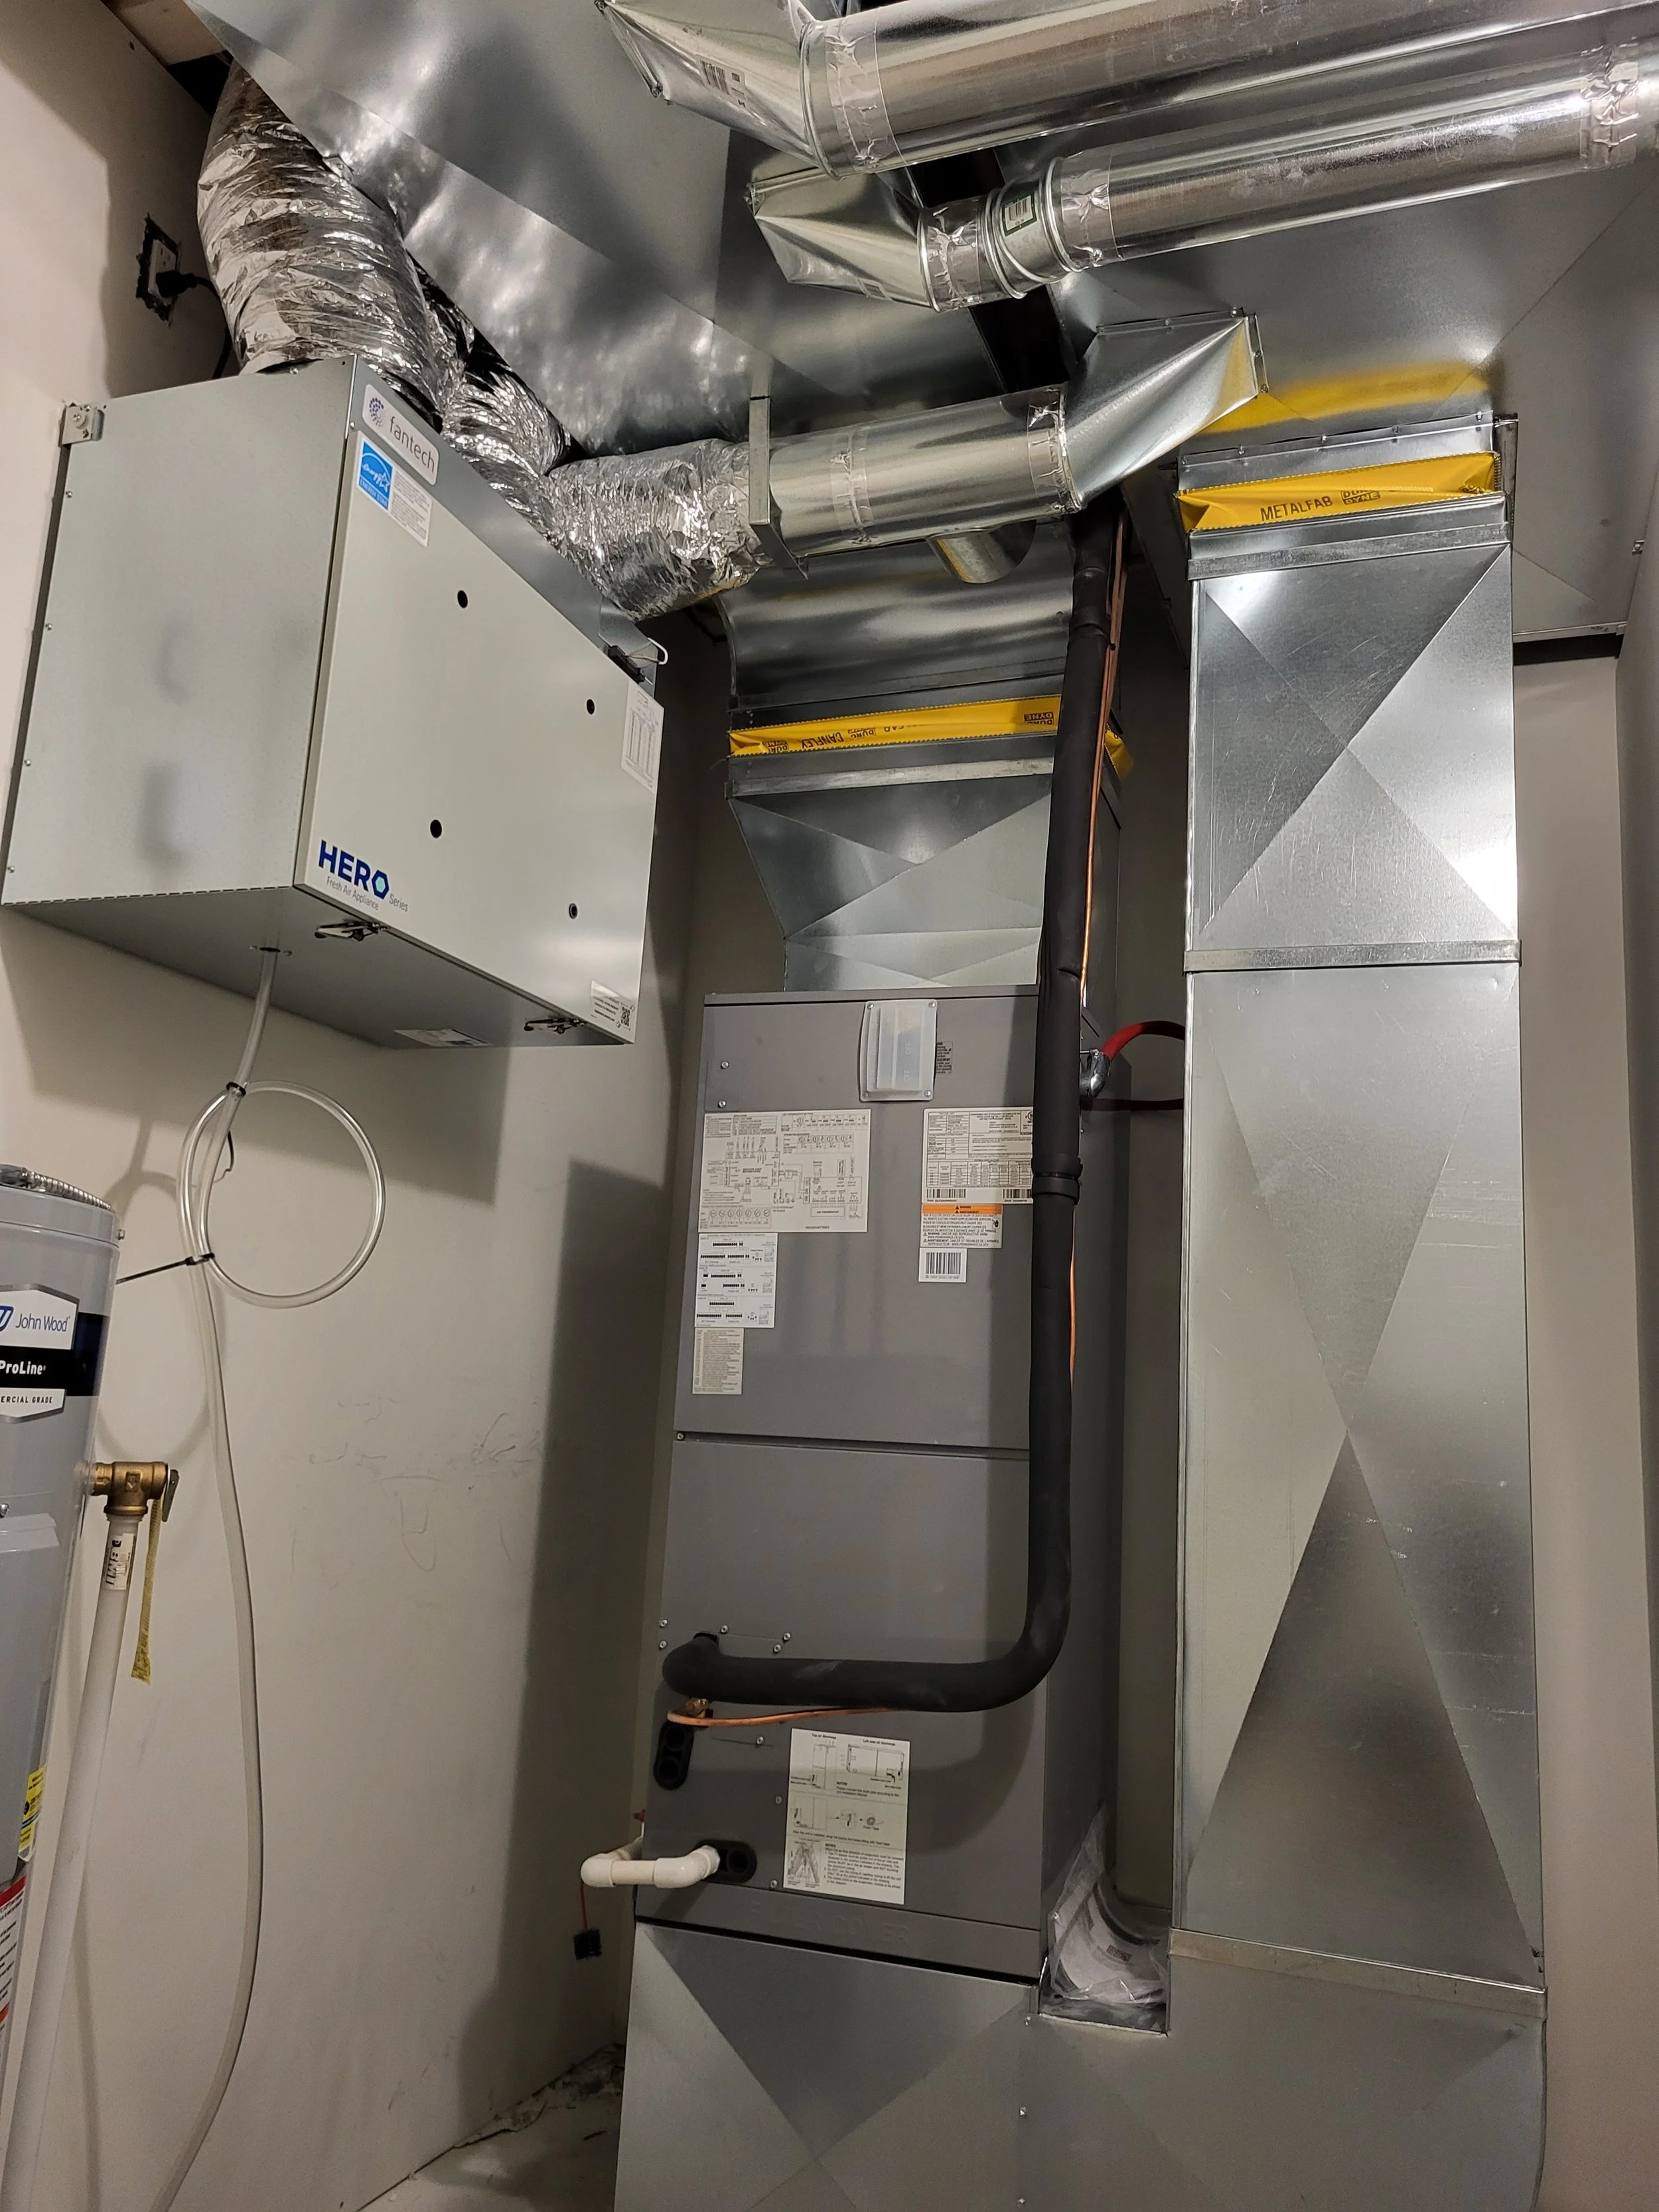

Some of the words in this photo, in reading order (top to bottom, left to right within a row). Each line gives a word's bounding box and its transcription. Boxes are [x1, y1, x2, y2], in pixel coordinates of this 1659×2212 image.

[390, 416, 435, 473] fantech
[1260, 496, 1333, 521] METALFAB
[319, 839, 390, 900] HERO
[389, 893, 409, 913] Series
[326, 875, 342, 892] Fresh
[342, 885, 352, 896] Air
[352, 889, 379, 911] Appliance
[15, 1313, 42, 1331] John
[44, 1315, 68, 1333] Wood
